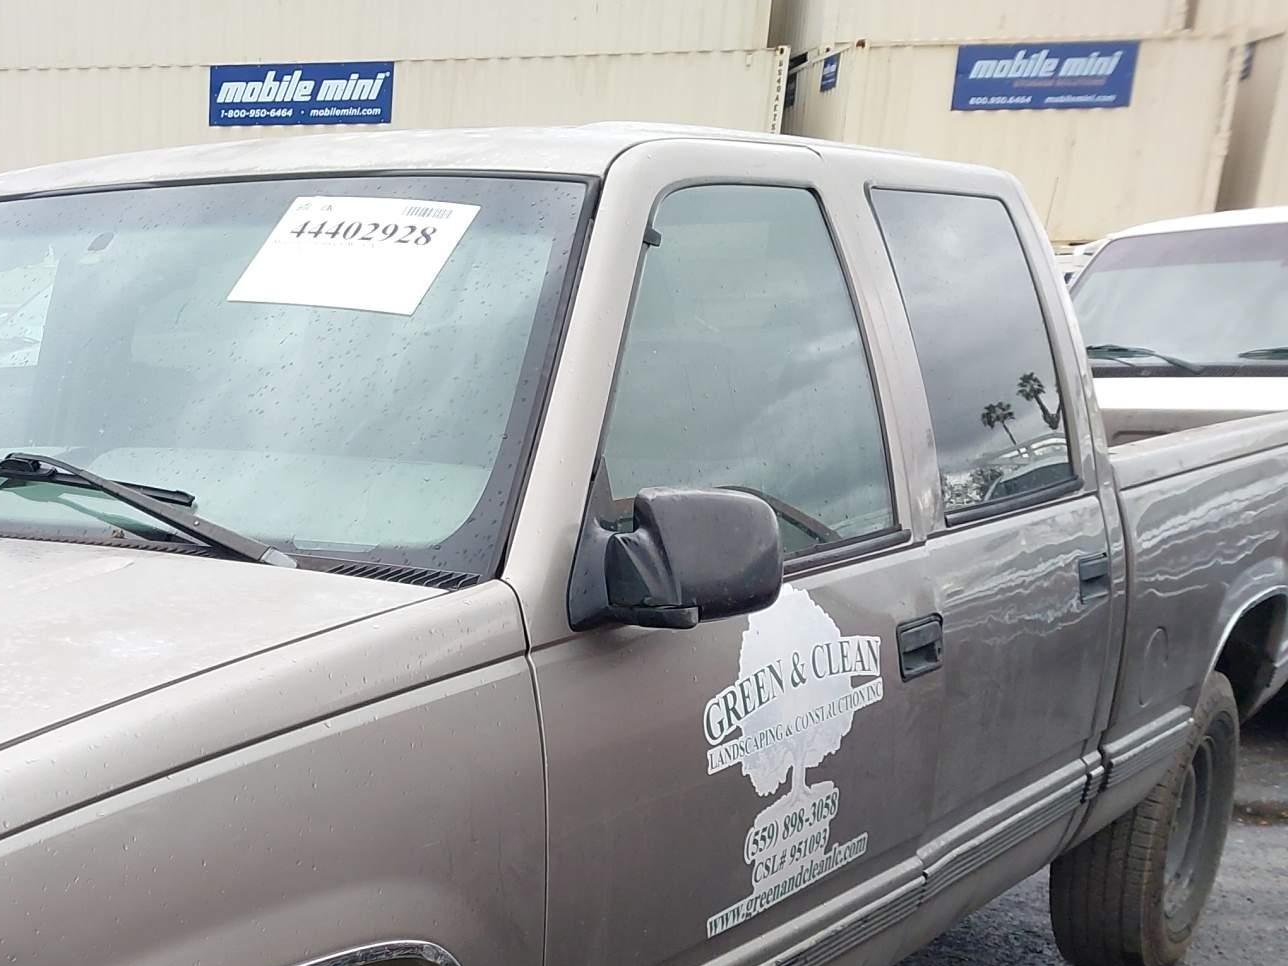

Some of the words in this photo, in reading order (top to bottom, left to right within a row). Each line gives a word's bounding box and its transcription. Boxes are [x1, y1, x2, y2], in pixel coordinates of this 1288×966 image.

[217, 70, 315, 103] mobile
[316, 72, 390, 101] mini
[969, 50, 1060, 79] mobile
[1058, 51, 1124, 77] mini
[219, 108, 293, 118] 1-800-950-6464
[309, 106, 381, 117] mobilemini.com
[290, 220, 437, 246] 44402928
[705, 659, 785, 740] GREEN
[790, 651, 807, 688] &
[812, 639, 879, 679] CLEAN
[710, 724, 783, 769] LANDSCAPING
[785, 725, 793, 737] &
[795, 689, 863, 732] CONSTRUCTION
[865, 681, 882, 701] INC
[746, 820, 779, 861] (559)
[782, 792, 838, 841] 898-3058
[754, 848, 787, 883] CSL#
[789, 828, 827, 866] 951093
